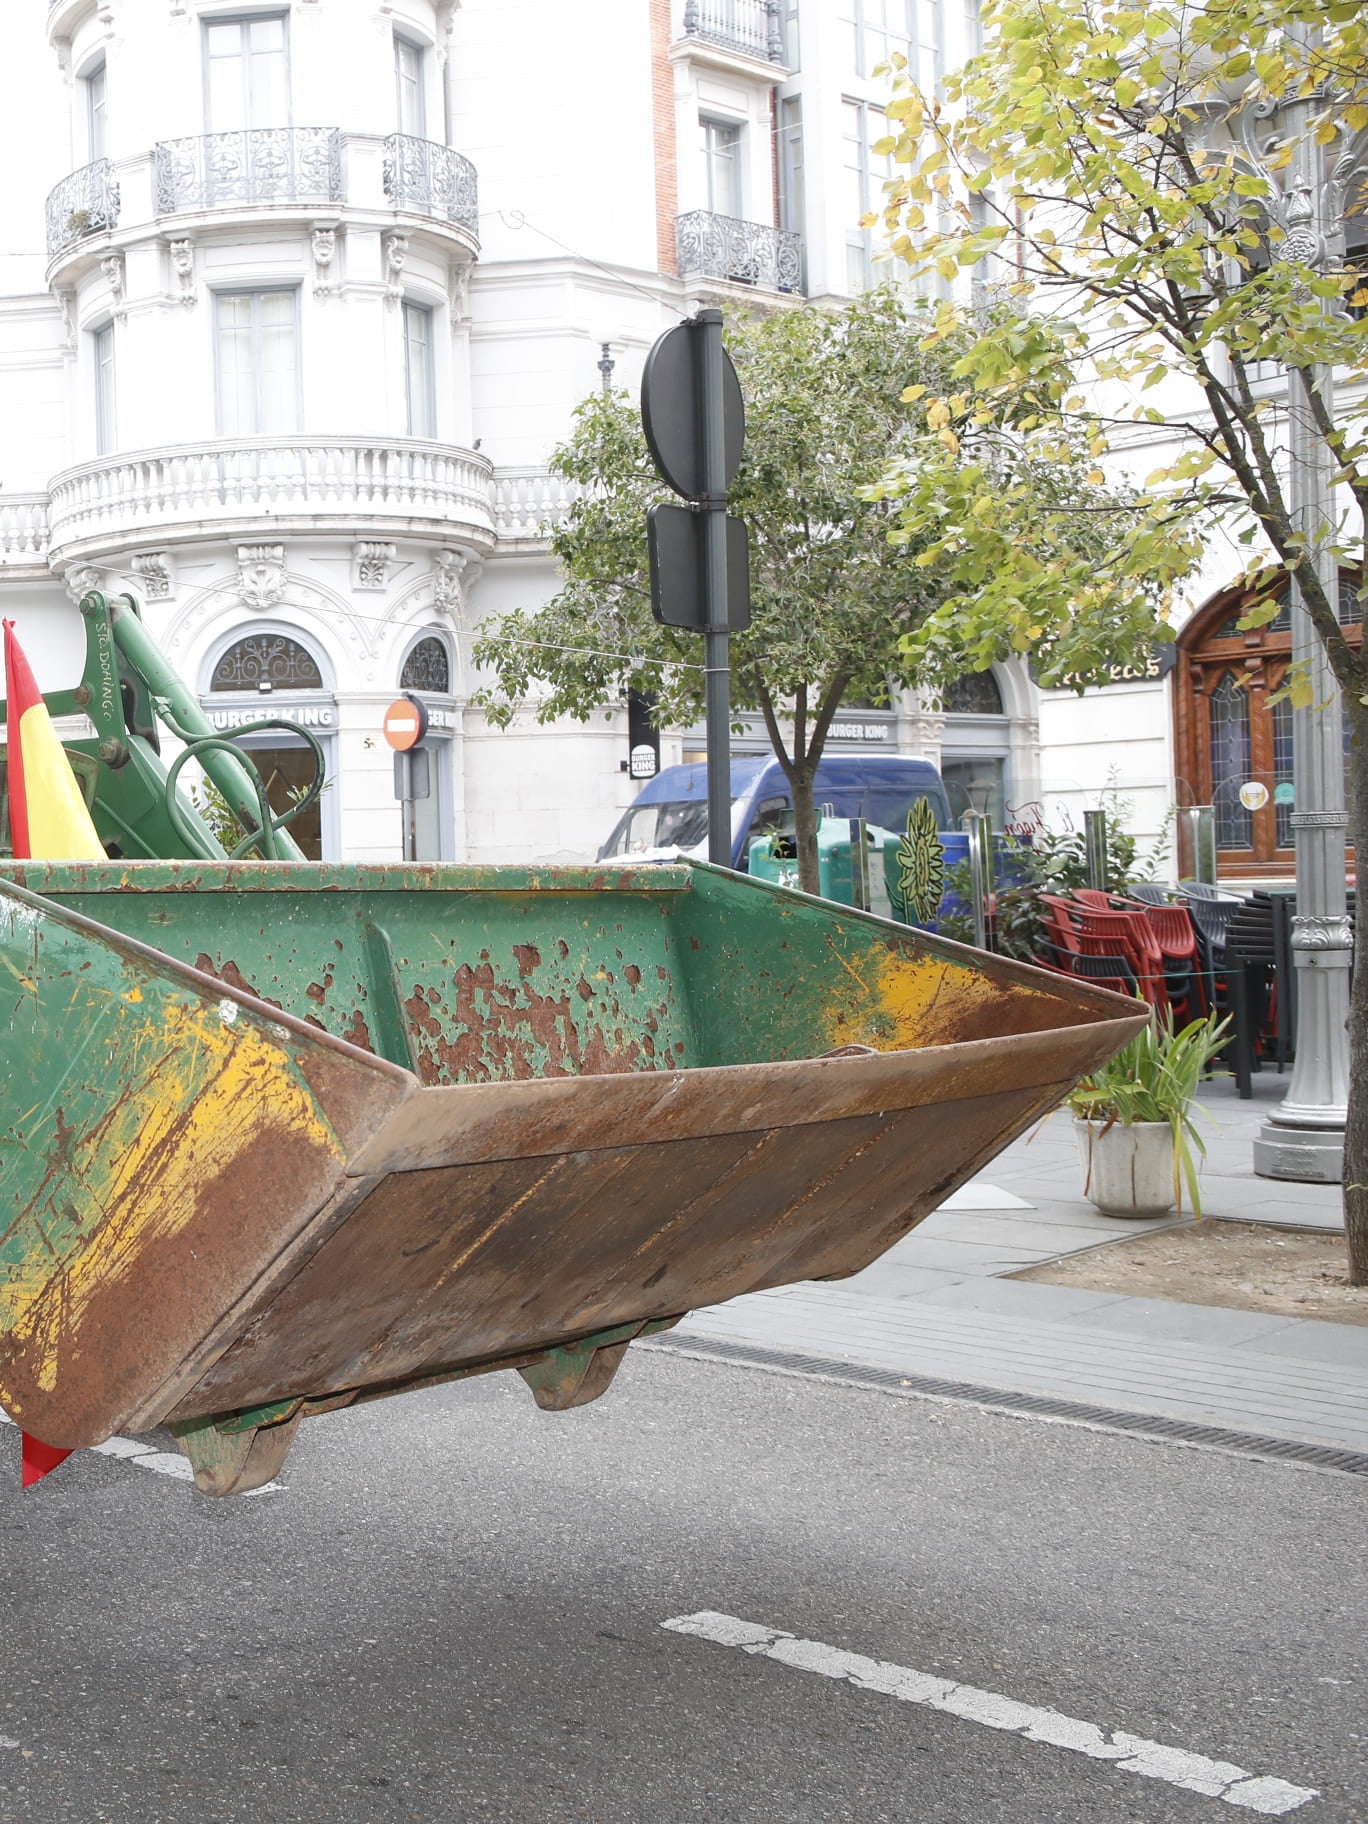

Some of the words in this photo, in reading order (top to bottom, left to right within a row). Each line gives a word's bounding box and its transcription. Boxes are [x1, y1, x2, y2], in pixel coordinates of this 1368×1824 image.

[281, 708, 332, 725] KING
[826, 723, 864, 738] BURGER
[864, 724, 888, 739] KING
[631, 753, 656, 762] BURGER
[631, 761, 656, 771] KING
